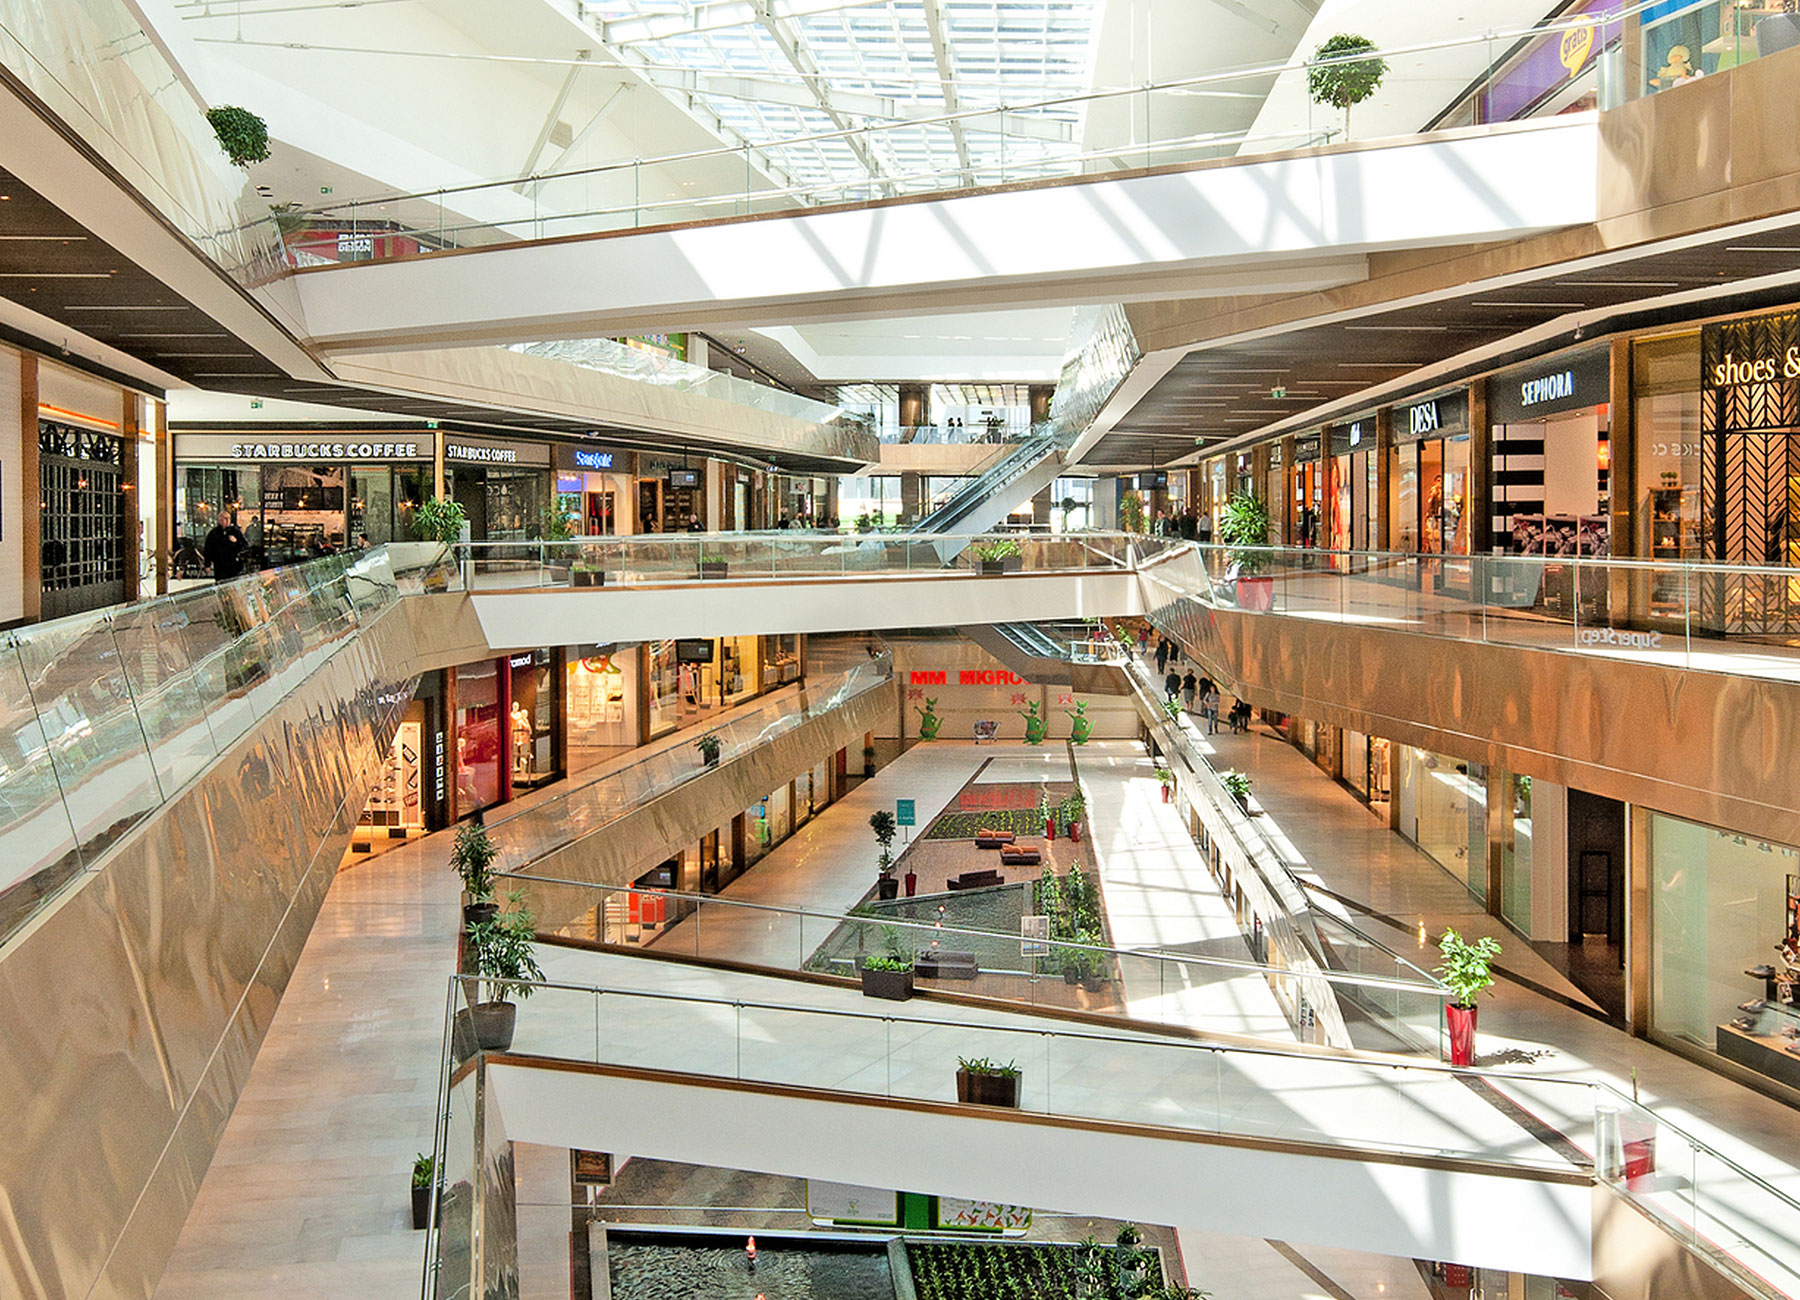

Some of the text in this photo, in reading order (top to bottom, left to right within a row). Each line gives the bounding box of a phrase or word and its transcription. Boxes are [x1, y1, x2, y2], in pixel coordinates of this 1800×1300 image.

[1715, 346, 1800, 386] shoes &
[1521, 371, 1574, 406] SEPHORA
[1410, 401, 1439, 434] DESA
[231, 443, 418, 458] STARBUCKS COFFEE
[447, 444, 517, 463] STARBUCKS COFFEE
[910, 670, 1033, 686] MM MIGRO
